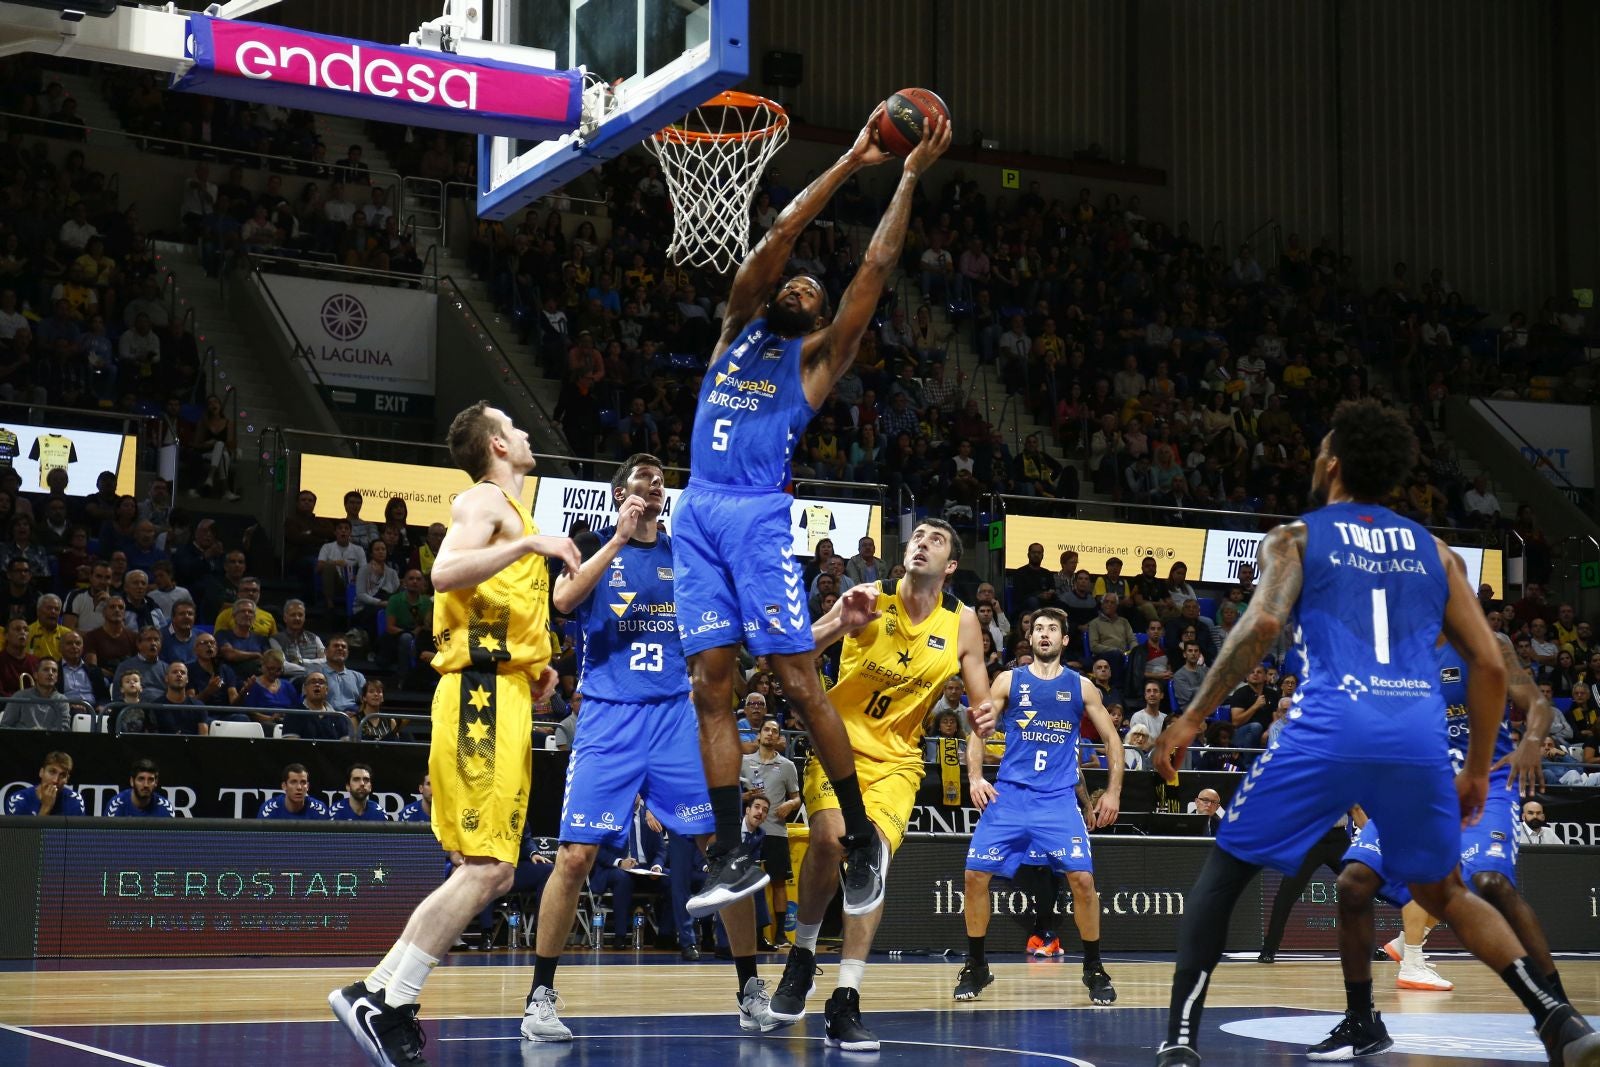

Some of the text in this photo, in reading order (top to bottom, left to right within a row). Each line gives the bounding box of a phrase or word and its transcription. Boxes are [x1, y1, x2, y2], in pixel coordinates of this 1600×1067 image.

[235, 40, 477, 110] endesa
[321, 345, 393, 366] LAGUNA
[374, 394, 409, 413] EXIT
[707, 390, 759, 411] BURGOS
[712, 419, 732, 451] 5
[562, 487, 606, 512] VISITA
[992, 526, 999, 544] P
[1058, 542, 1129, 556] www.cbcanarias.net
[1347, 552, 1428, 575] ARZUAGA
[1585, 566, 1596, 585] Q
[618, 620, 675, 632] BURGOS
[690, 620, 731, 635] LEXUS
[1371, 588, 1390, 664] 1
[629, 642, 663, 672] 23
[864, 689, 892, 720] 19
[1022, 731, 1065, 744] BURGOS
[1034, 750, 1048, 771] 6
[102, 871, 358, 897] IBEROSTAR
